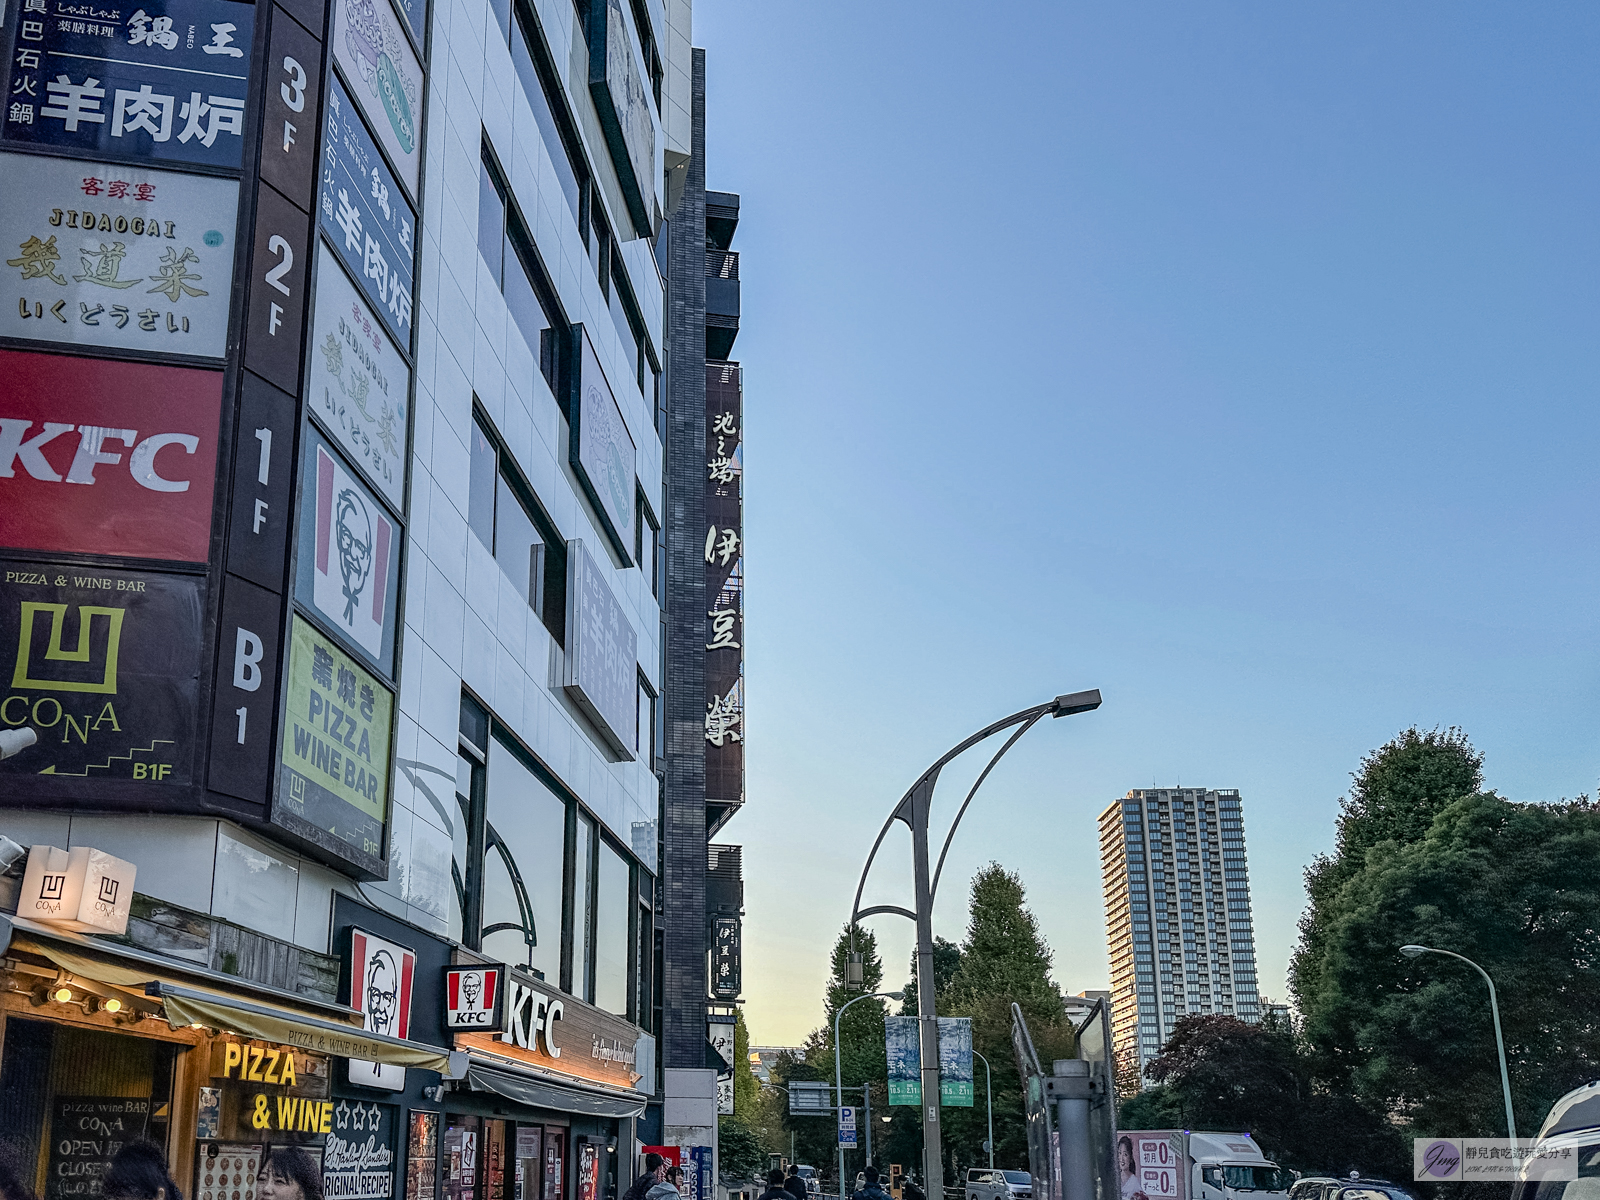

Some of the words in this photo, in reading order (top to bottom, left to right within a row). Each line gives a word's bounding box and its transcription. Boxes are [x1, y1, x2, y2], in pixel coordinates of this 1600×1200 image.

[57, 2, 121, 19] しゃぶしゃぶ
[57, 20, 114, 38] 薬膳料理
[40, 74, 246, 149] 羊肉炉
[80, 176, 157, 202] 客家宴
[334, 187, 413, 331] 羊肉炉
[18, 297, 191, 334] いくどうさい
[0, 417, 200, 493] KFC
[5, 571, 49, 586] PIZZA
[54, 574, 68, 587] &
[73, 576, 112, 590] WINE
[116, 579, 147, 592] BAR
[0, 696, 122, 744] CONA
[308, 688, 372, 764] PIZZA
[132, 762, 173, 781] B1F
[293, 722, 342, 782] WINE
[343, 761, 379, 805] BAR
[287, 797, 305, 816] CONA
[35, 900, 62, 914] CONA
[94, 901, 116, 918] CONA
[453, 1011, 487, 1024] KFC
[502, 979, 565, 1059] KFC
[288, 1030, 315, 1048] PIZZA
[317, 1036, 326, 1050] &
[329, 1038, 351, 1055] WINE
[352, 1043, 368, 1057] BAR
[223, 1042, 297, 1087] PIZZA
[62, 1102, 95, 1117] pizza
[98, 1104, 124, 1113] wine
[125, 1101, 147, 1113] BAR
[252, 1094, 272, 1129] &
[276, 1096, 335, 1134] WINE
[842, 1108, 852, 1122] P
[79, 1116, 124, 1136] CONA
[58, 1139, 103, 1156] OPEN
[360, 1174, 389, 1195] RECIPE
